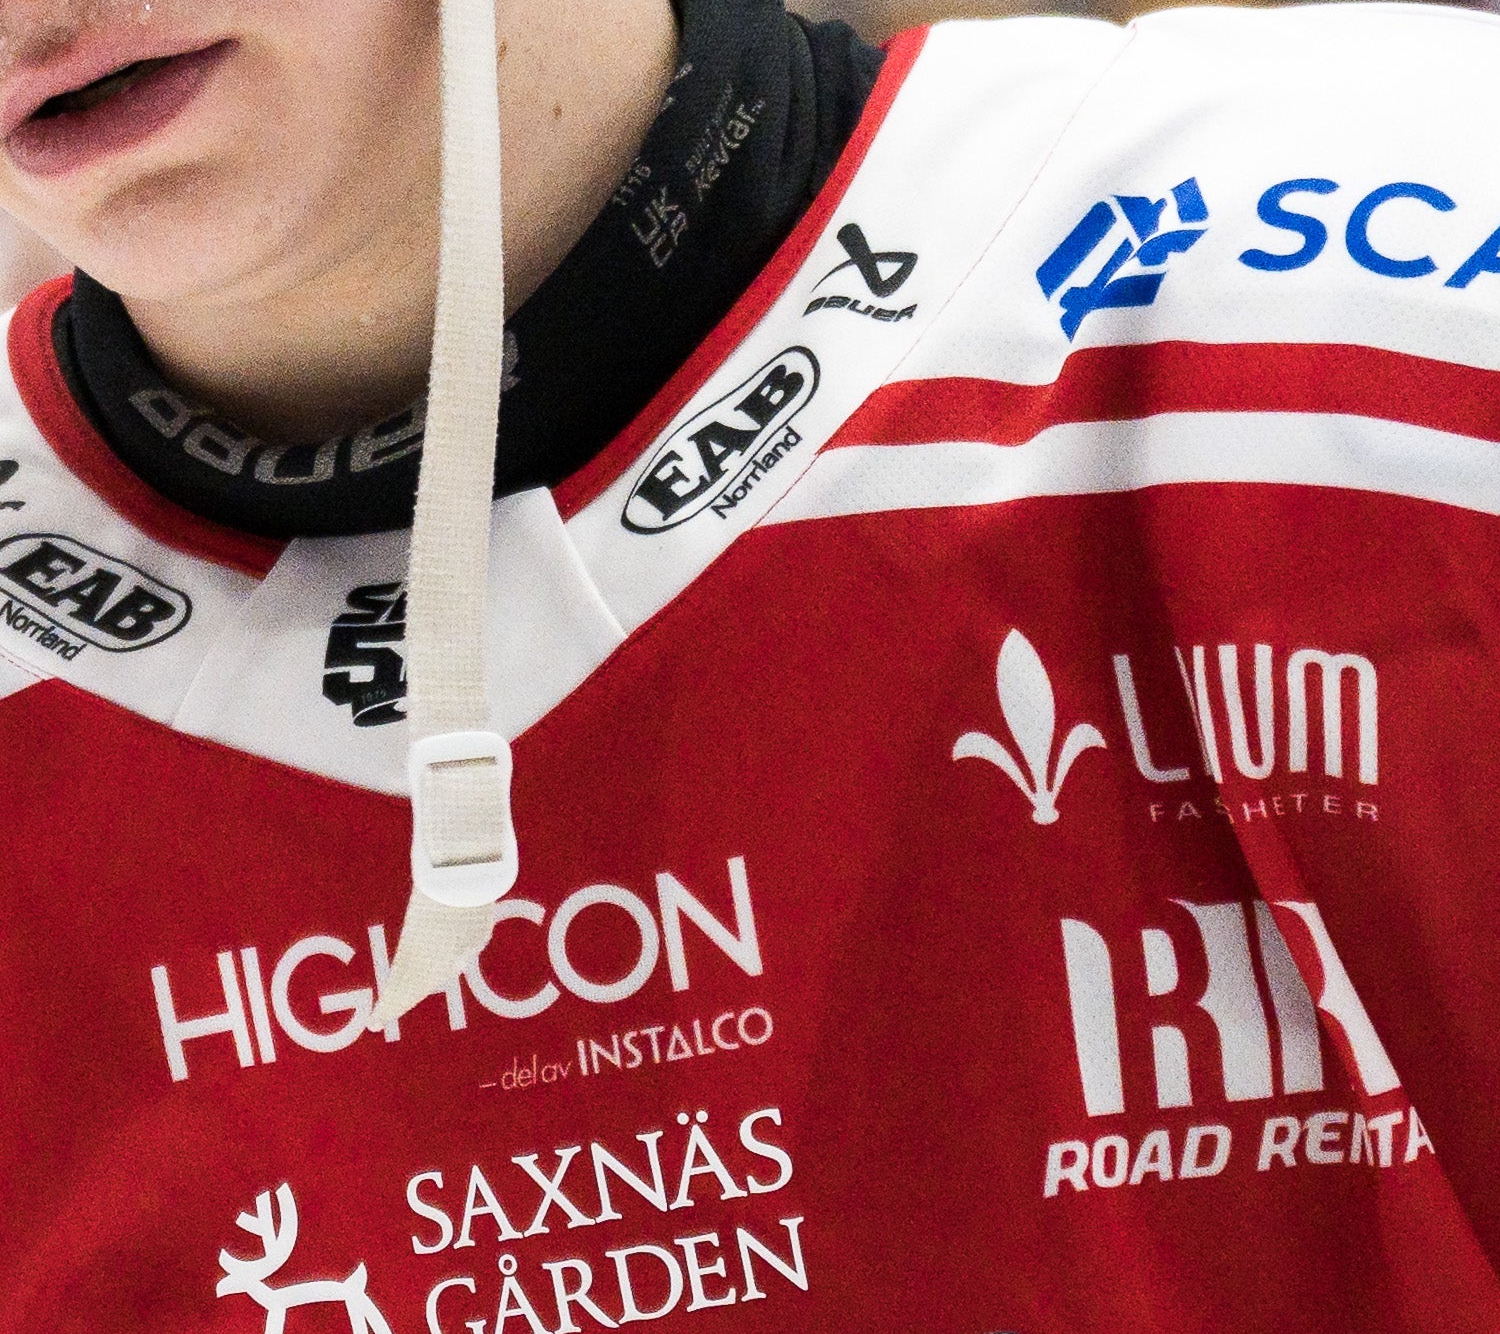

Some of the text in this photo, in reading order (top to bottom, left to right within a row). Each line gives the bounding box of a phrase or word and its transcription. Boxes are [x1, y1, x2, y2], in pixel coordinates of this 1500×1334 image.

[632, 364, 805, 521] EAB
[711, 425, 803, 520] Norrland
[577, 1006, 775, 1078] INSTALCO
[406, 1108, 795, 1256] SAXNÄS
[1042, 1125, 1233, 1199] ROAD
